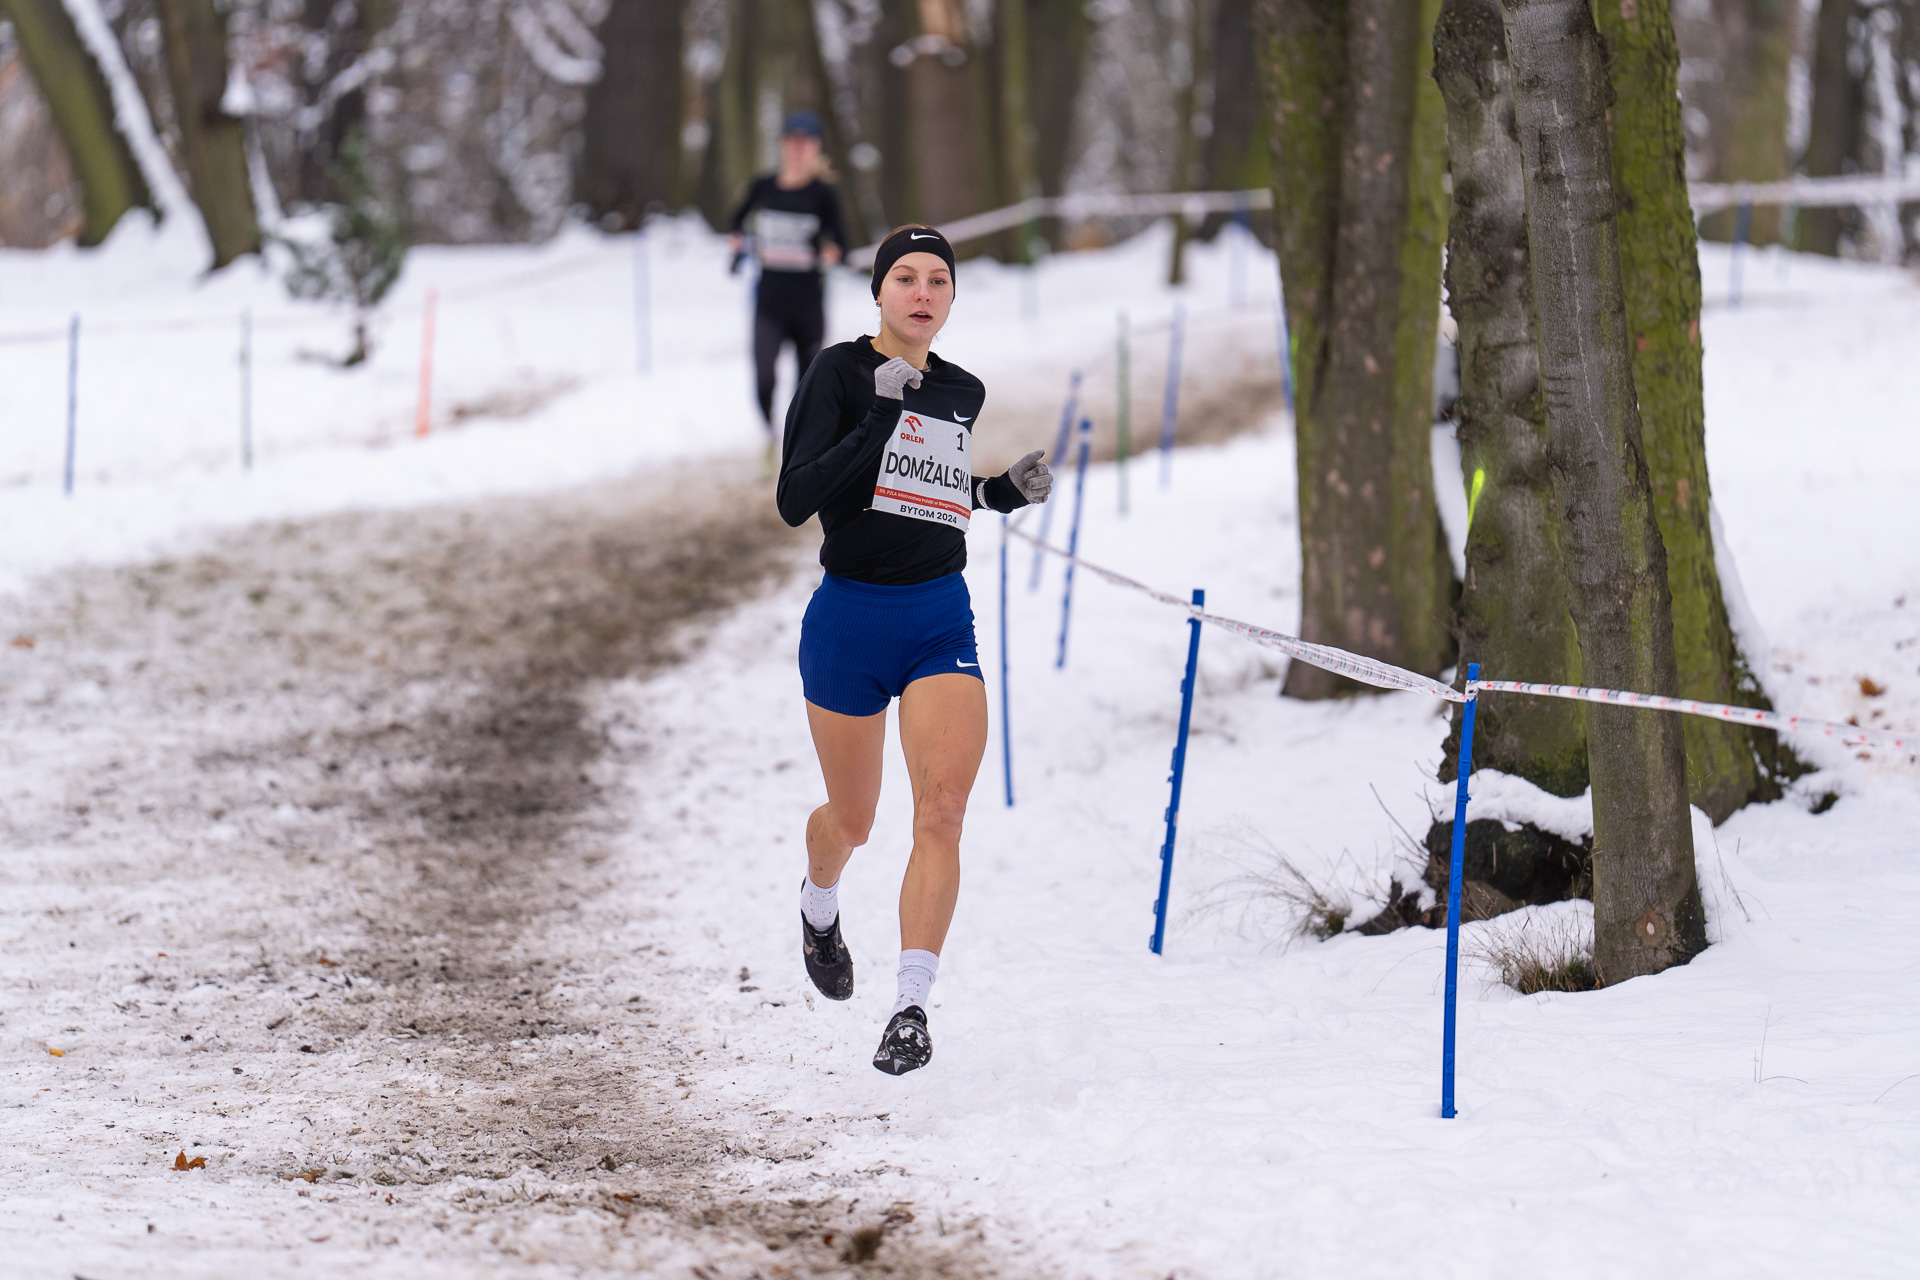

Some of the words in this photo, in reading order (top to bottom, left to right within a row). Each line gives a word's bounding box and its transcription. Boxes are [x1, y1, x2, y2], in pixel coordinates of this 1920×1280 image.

[900, 432, 924, 444] ORLEN
[957, 432, 964, 452] 1
[885, 451, 970, 496] DOMŻALSKA
[900, 504, 935, 519] BYTOM
[936, 511, 957, 524] 2024
